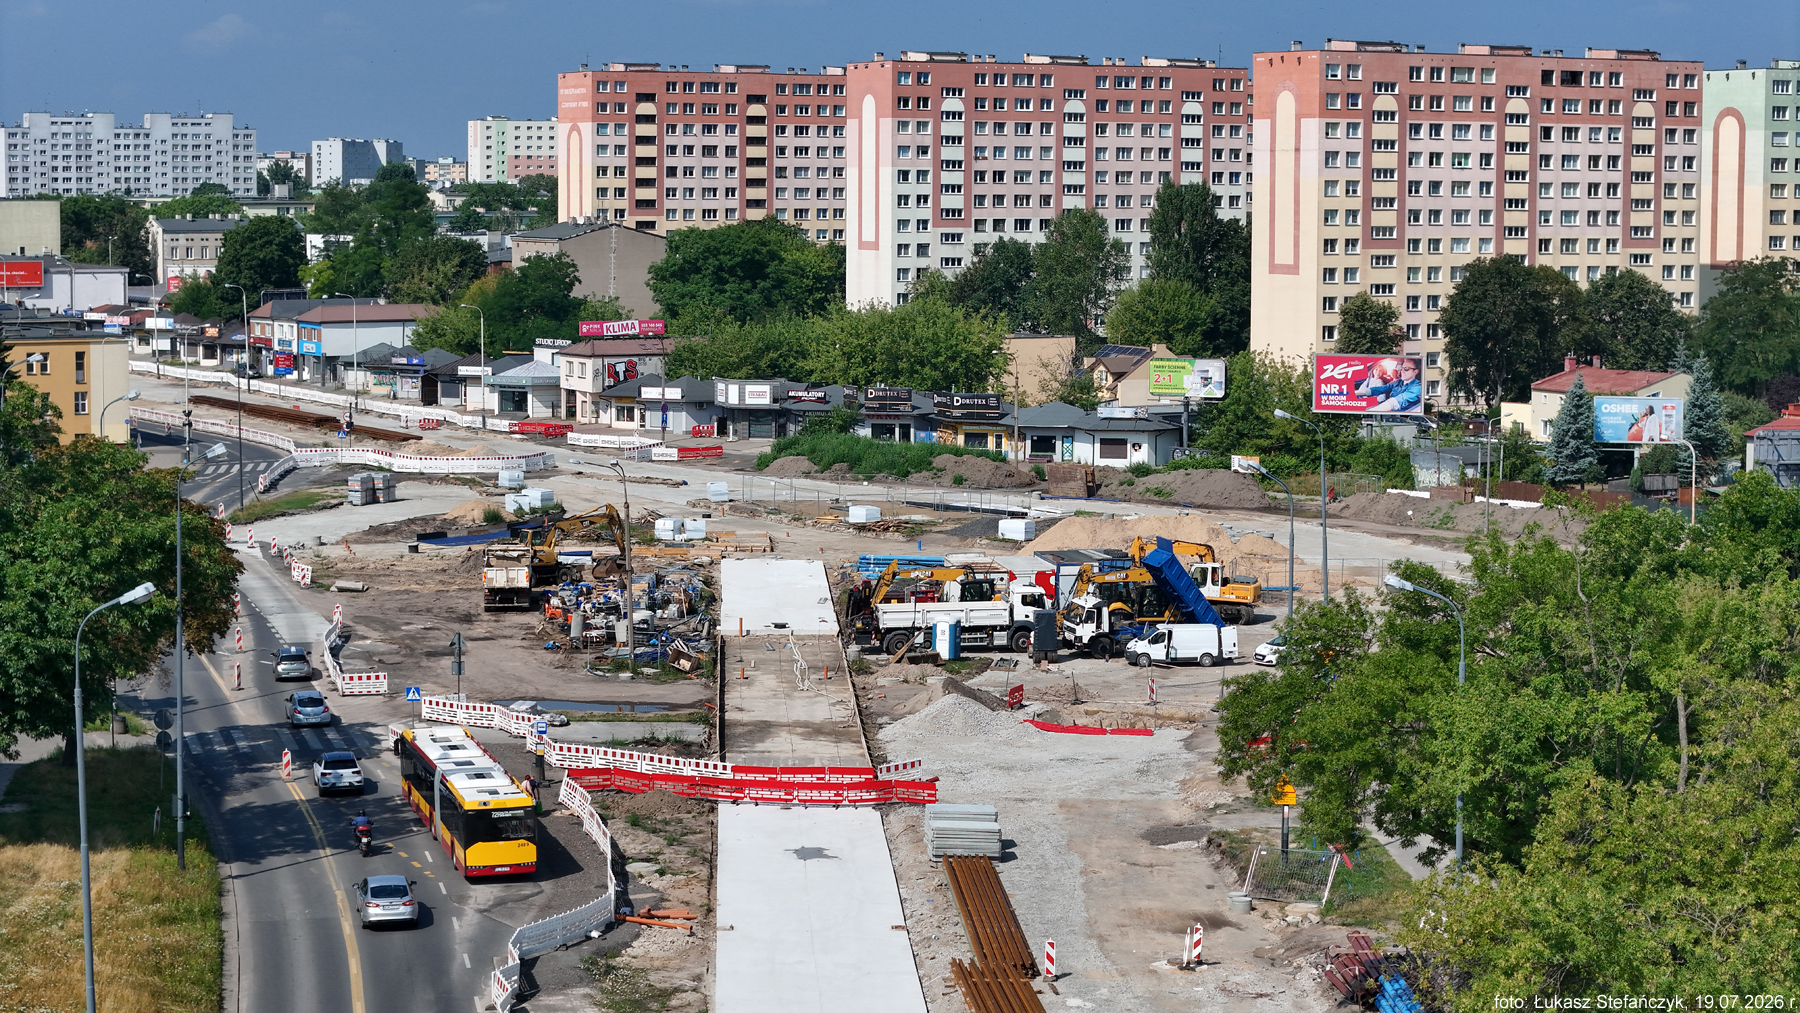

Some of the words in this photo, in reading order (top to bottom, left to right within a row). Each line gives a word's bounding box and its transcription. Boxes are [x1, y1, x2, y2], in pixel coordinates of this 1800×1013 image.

[605, 321, 637, 334] KLIMA
[535, 338, 553, 346] STUDIO
[606, 359, 638, 382] RTS
[1320, 362, 1364, 379] ZET
[1153, 373, 1172, 383] 2+1
[788, 390, 825, 398] AKUMULATORY
[1321, 384, 1339, 394] NR
[1341, 384, 1347, 394] 1
[1601, 404, 1638, 413] OSHEE
